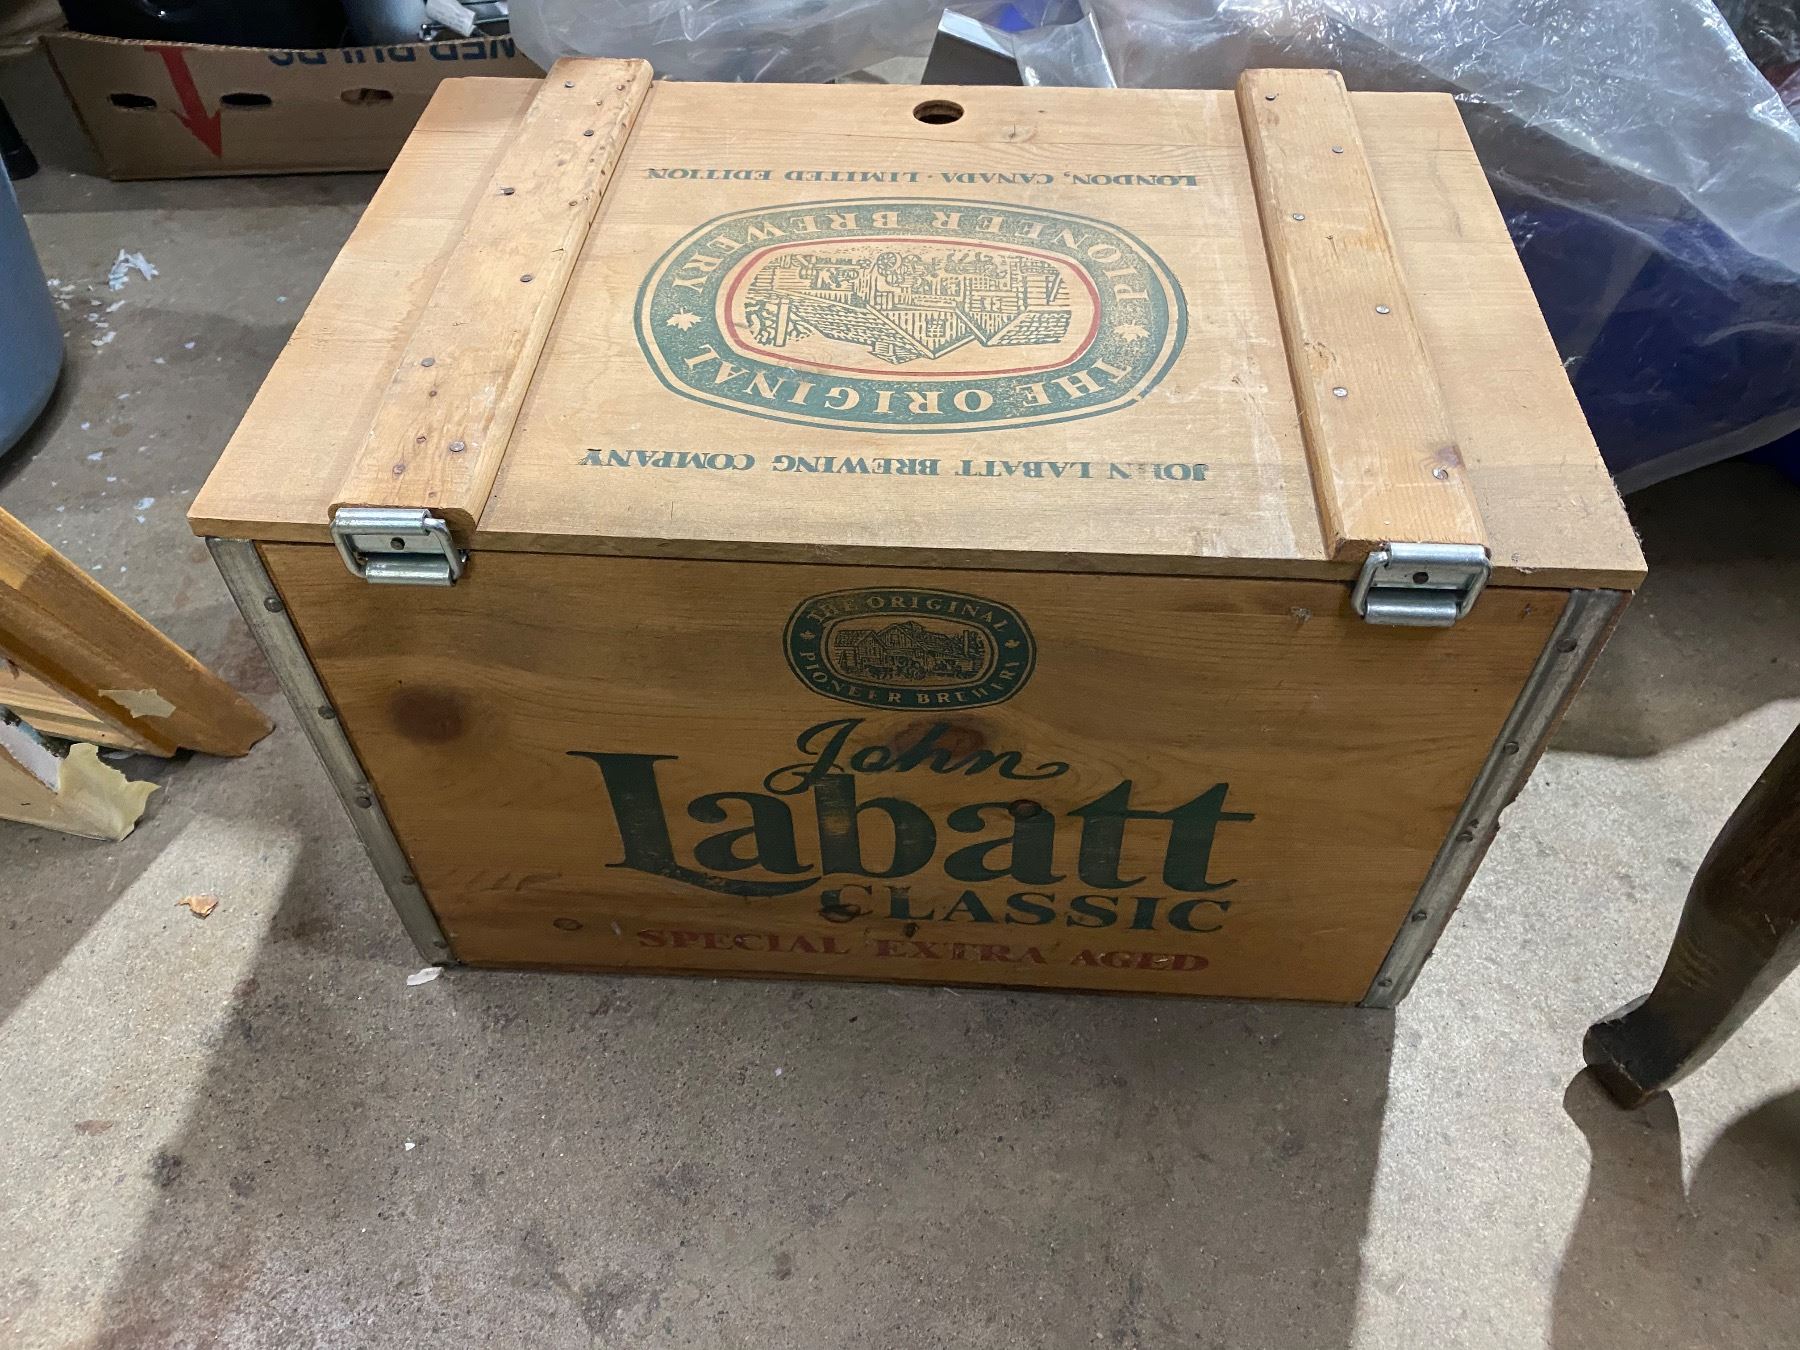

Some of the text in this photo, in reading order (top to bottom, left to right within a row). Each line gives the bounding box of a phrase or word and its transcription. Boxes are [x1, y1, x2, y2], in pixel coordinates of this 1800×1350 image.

[646, 167, 1198, 187] LONDON, CANADA LIMITED EDITION
[672, 211, 1150, 302] PIONEER BREWERY
[684, 344, 1132, 414] THE ORIGINAL
[578, 448, 756, 471] COMPANY
[771, 454, 941, 476] BREWING
[954, 458, 1094, 479] LABATT
[867, 595, 1009, 633] ORIGINAL
[799, 652, 901, 703] PIONEER
[763, 718, 1071, 796] John
[566, 751, 1256, 897] Labatt
[818, 883, 1232, 933] CLASSIC
[637, 928, 1210, 972] SPECIAL EXTRA AGED
